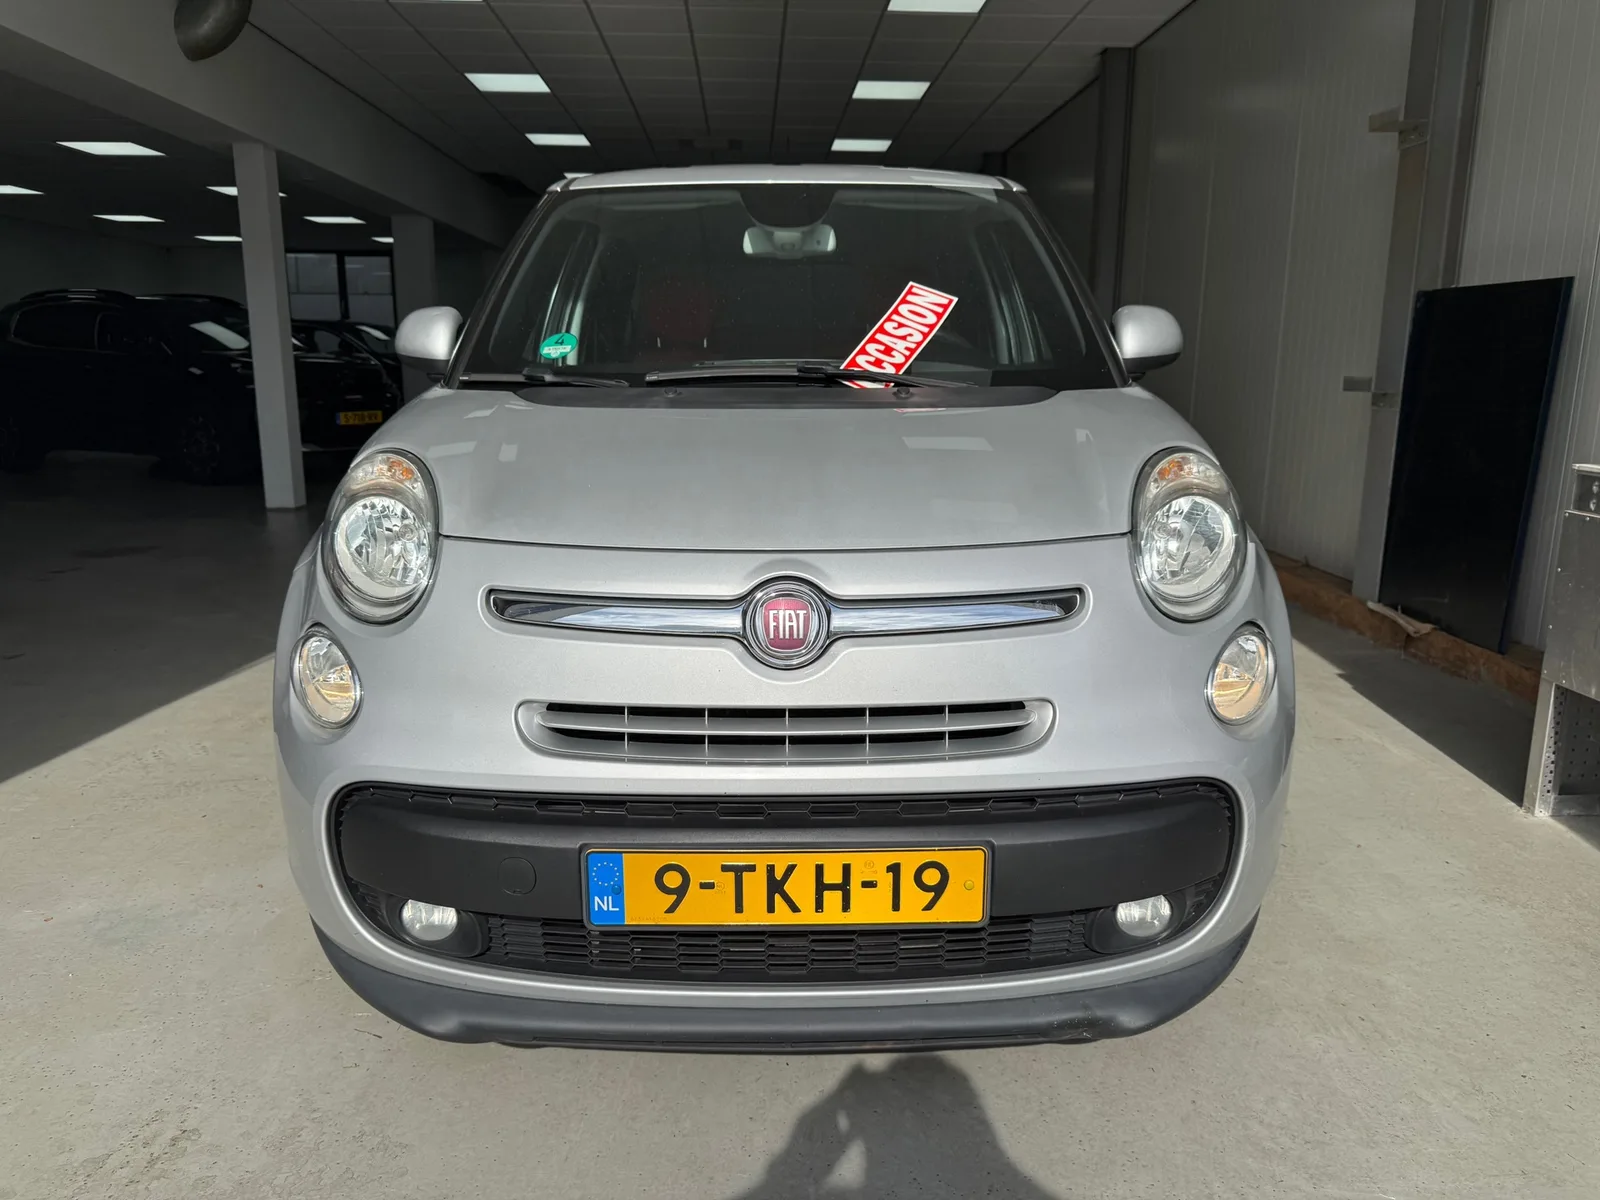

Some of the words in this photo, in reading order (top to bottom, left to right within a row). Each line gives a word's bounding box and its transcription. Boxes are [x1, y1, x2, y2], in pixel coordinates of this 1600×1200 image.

[554, 334, 566, 346] 4
[769, 609, 807, 639] FIAT
[654, 860, 950, 914] 9-TKH-19
[594, 895, 620, 911] NL
